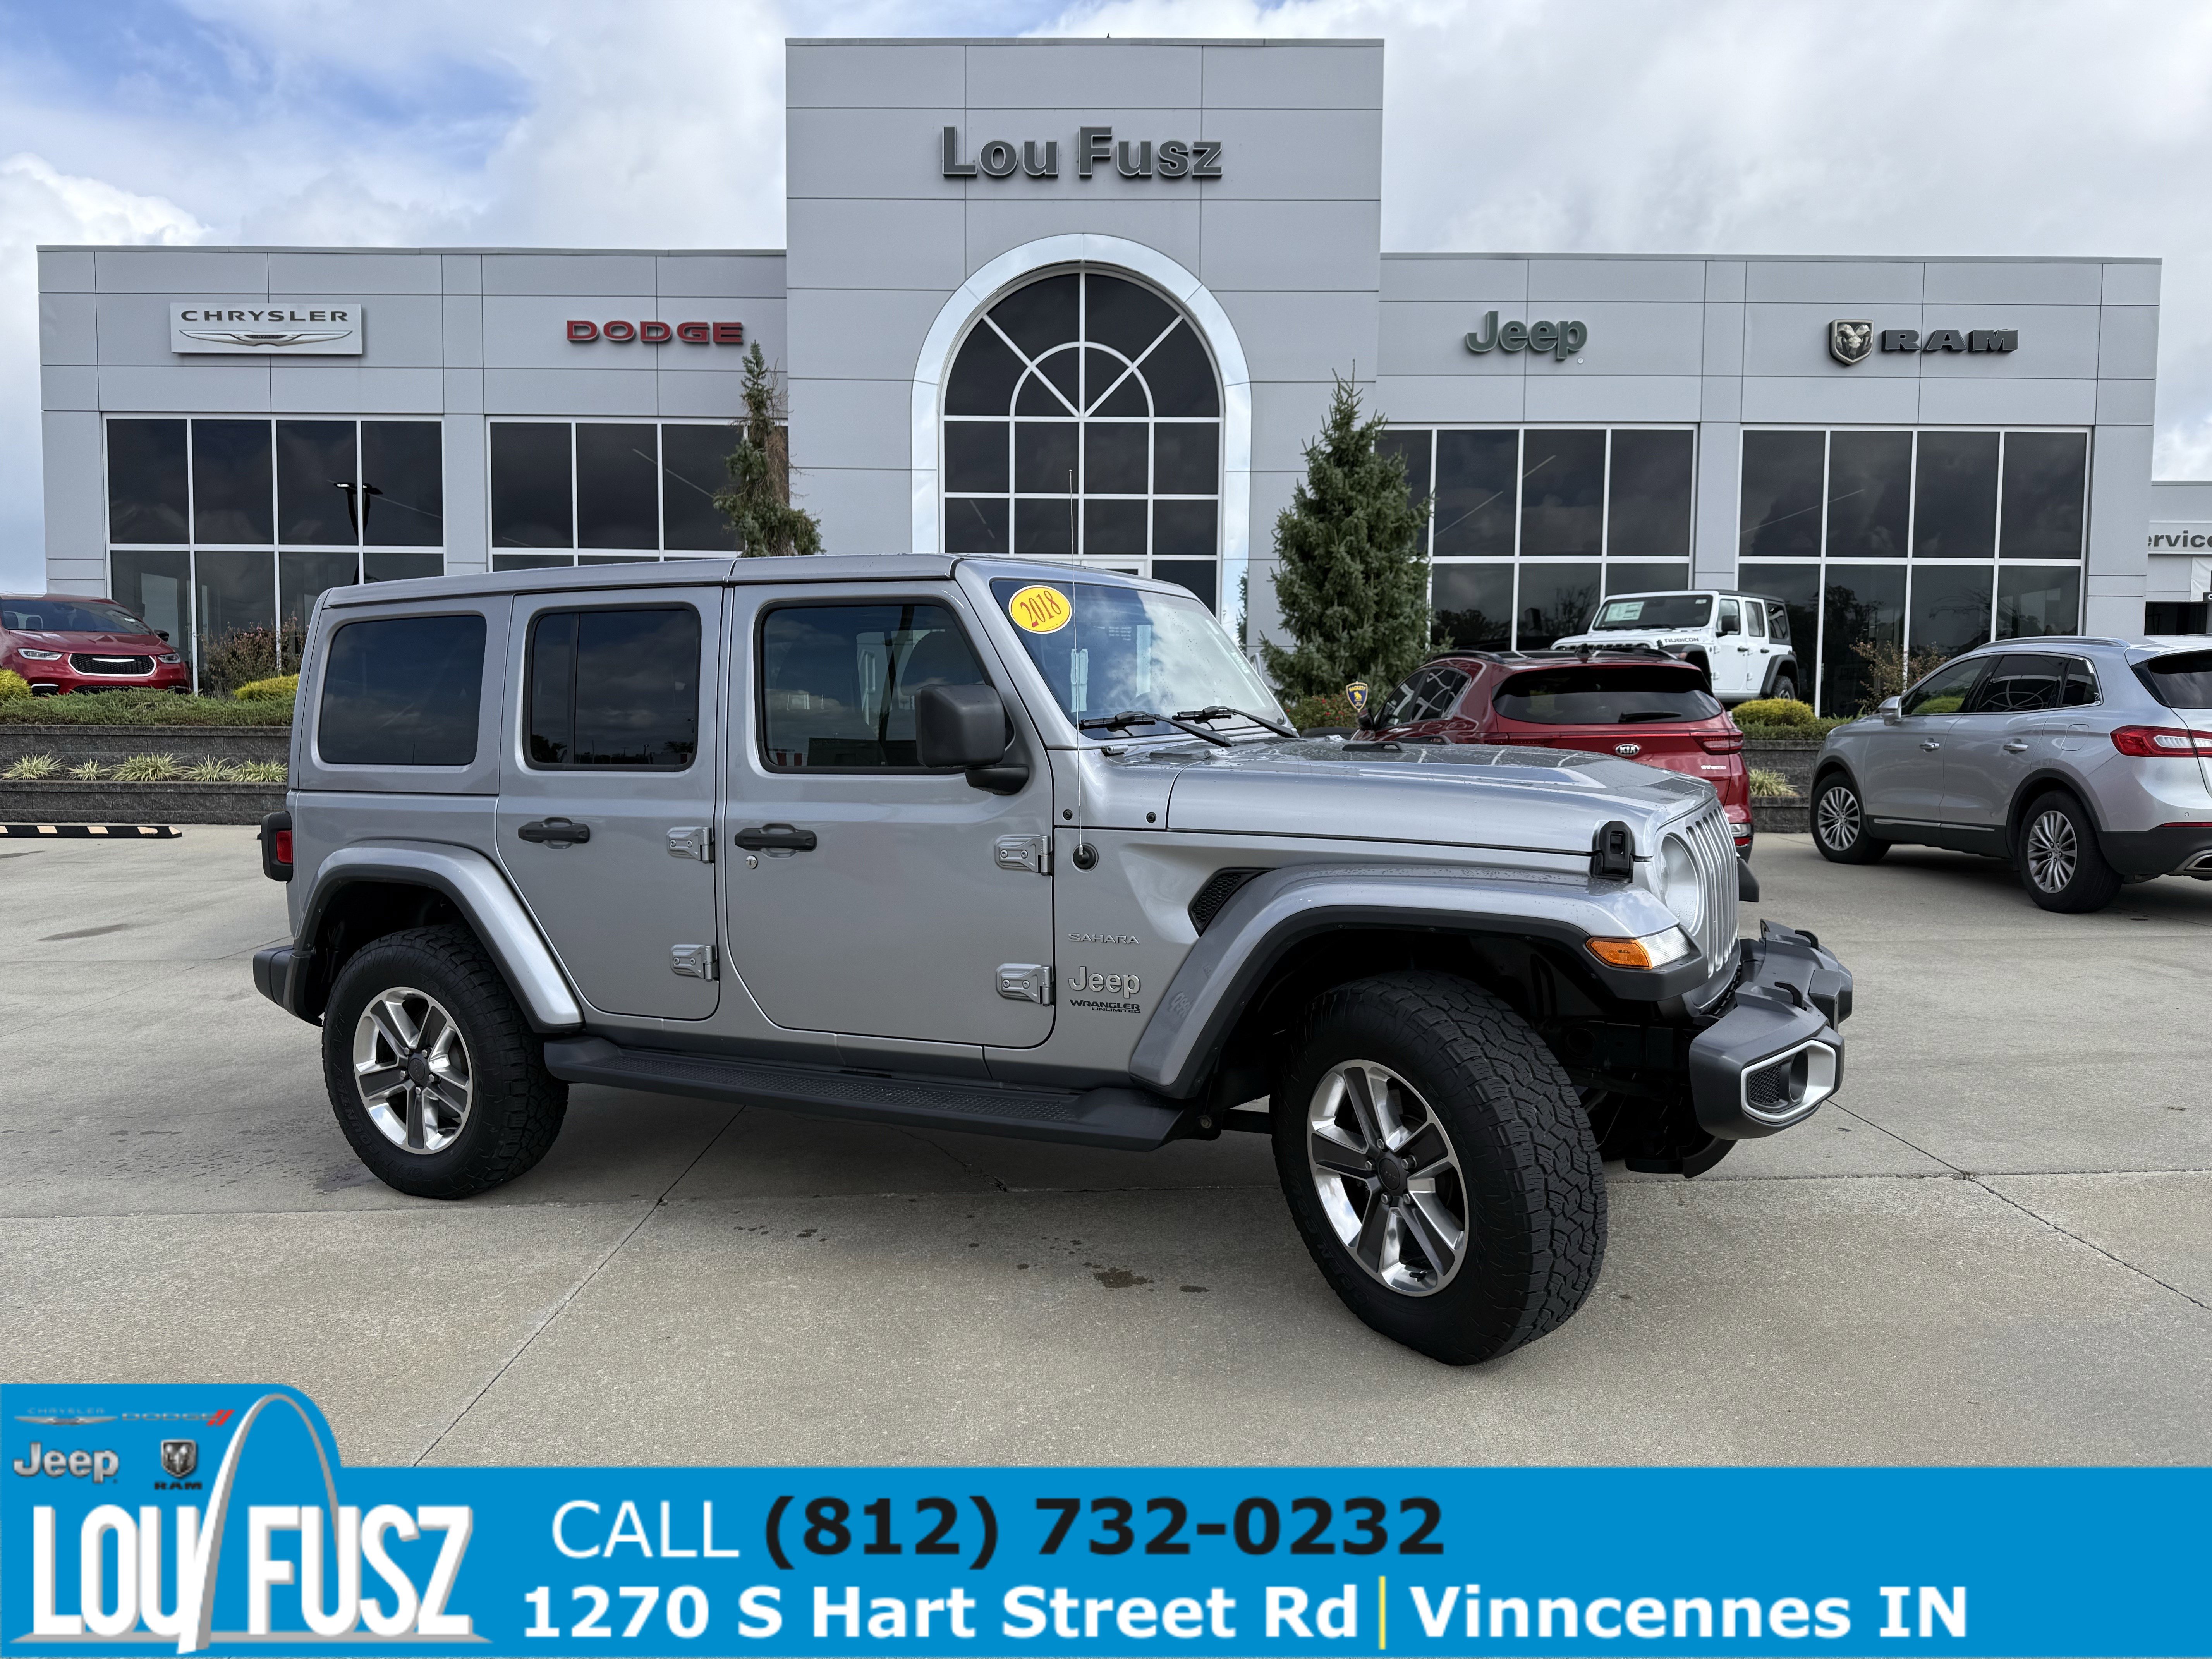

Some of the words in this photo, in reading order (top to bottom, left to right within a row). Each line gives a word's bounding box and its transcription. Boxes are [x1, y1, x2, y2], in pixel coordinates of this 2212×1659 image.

[942, 125, 1059, 178] Lou
[1078, 125, 1223, 179] Fusz
[180, 310, 348, 321] CHRYSLER
[567, 320, 743, 343] DODGE
[1466, 311, 1588, 361] Jeep
[1881, 329, 2018, 352] RAM
[1020, 590, 1061, 628] 2018
[1620, 746, 1636, 754] KIA
[1068, 933, 1140, 945] SAHARA
[1068, 966, 1141, 999] Jeep
[1069, 999, 1140, 1010] WRANGLER
